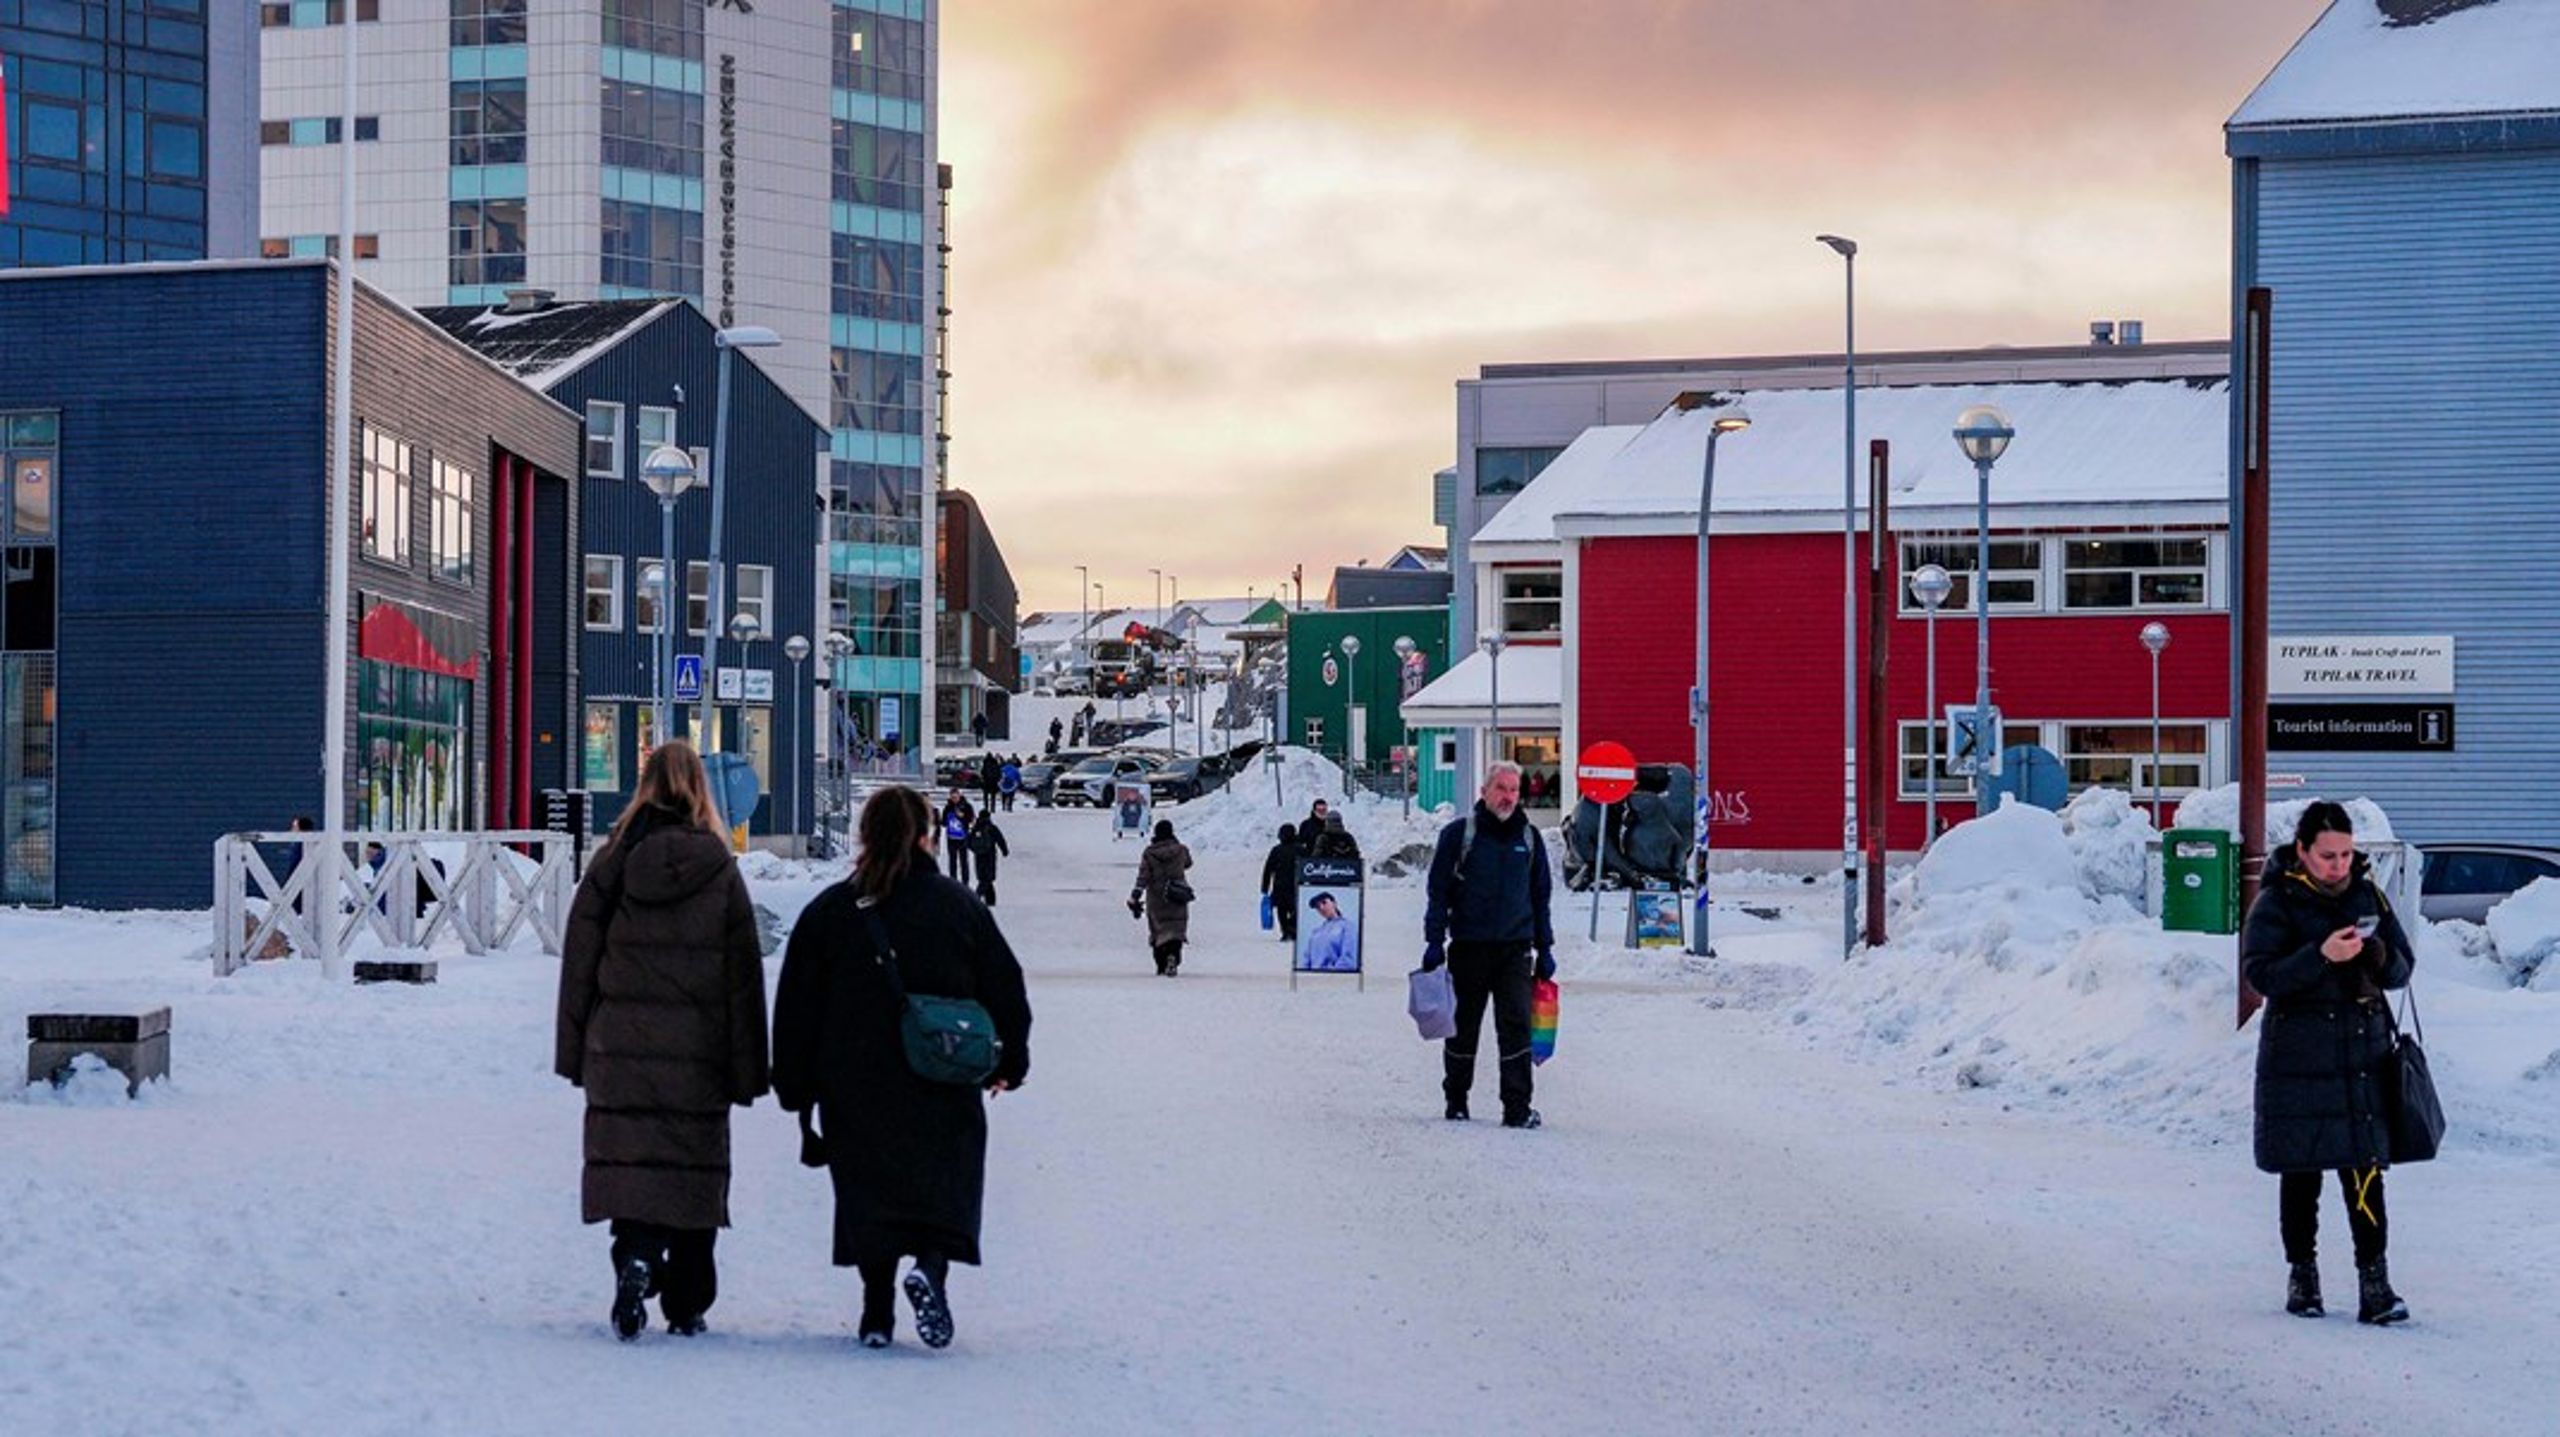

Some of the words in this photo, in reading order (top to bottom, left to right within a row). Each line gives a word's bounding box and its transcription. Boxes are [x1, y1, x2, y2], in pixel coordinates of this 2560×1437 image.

[2281, 646, 2340, 658] TUPILAK
[2375, 646, 2399, 658] Craft
[2400, 647, 2419, 657] and
[2303, 669, 2362, 681] TUPILAK
[2366, 669, 2418, 681] TRAVEL
[2275, 719, 2325, 734] Tourist
[2328, 718, 2413, 734] information
[1303, 862, 1356, 879] California
